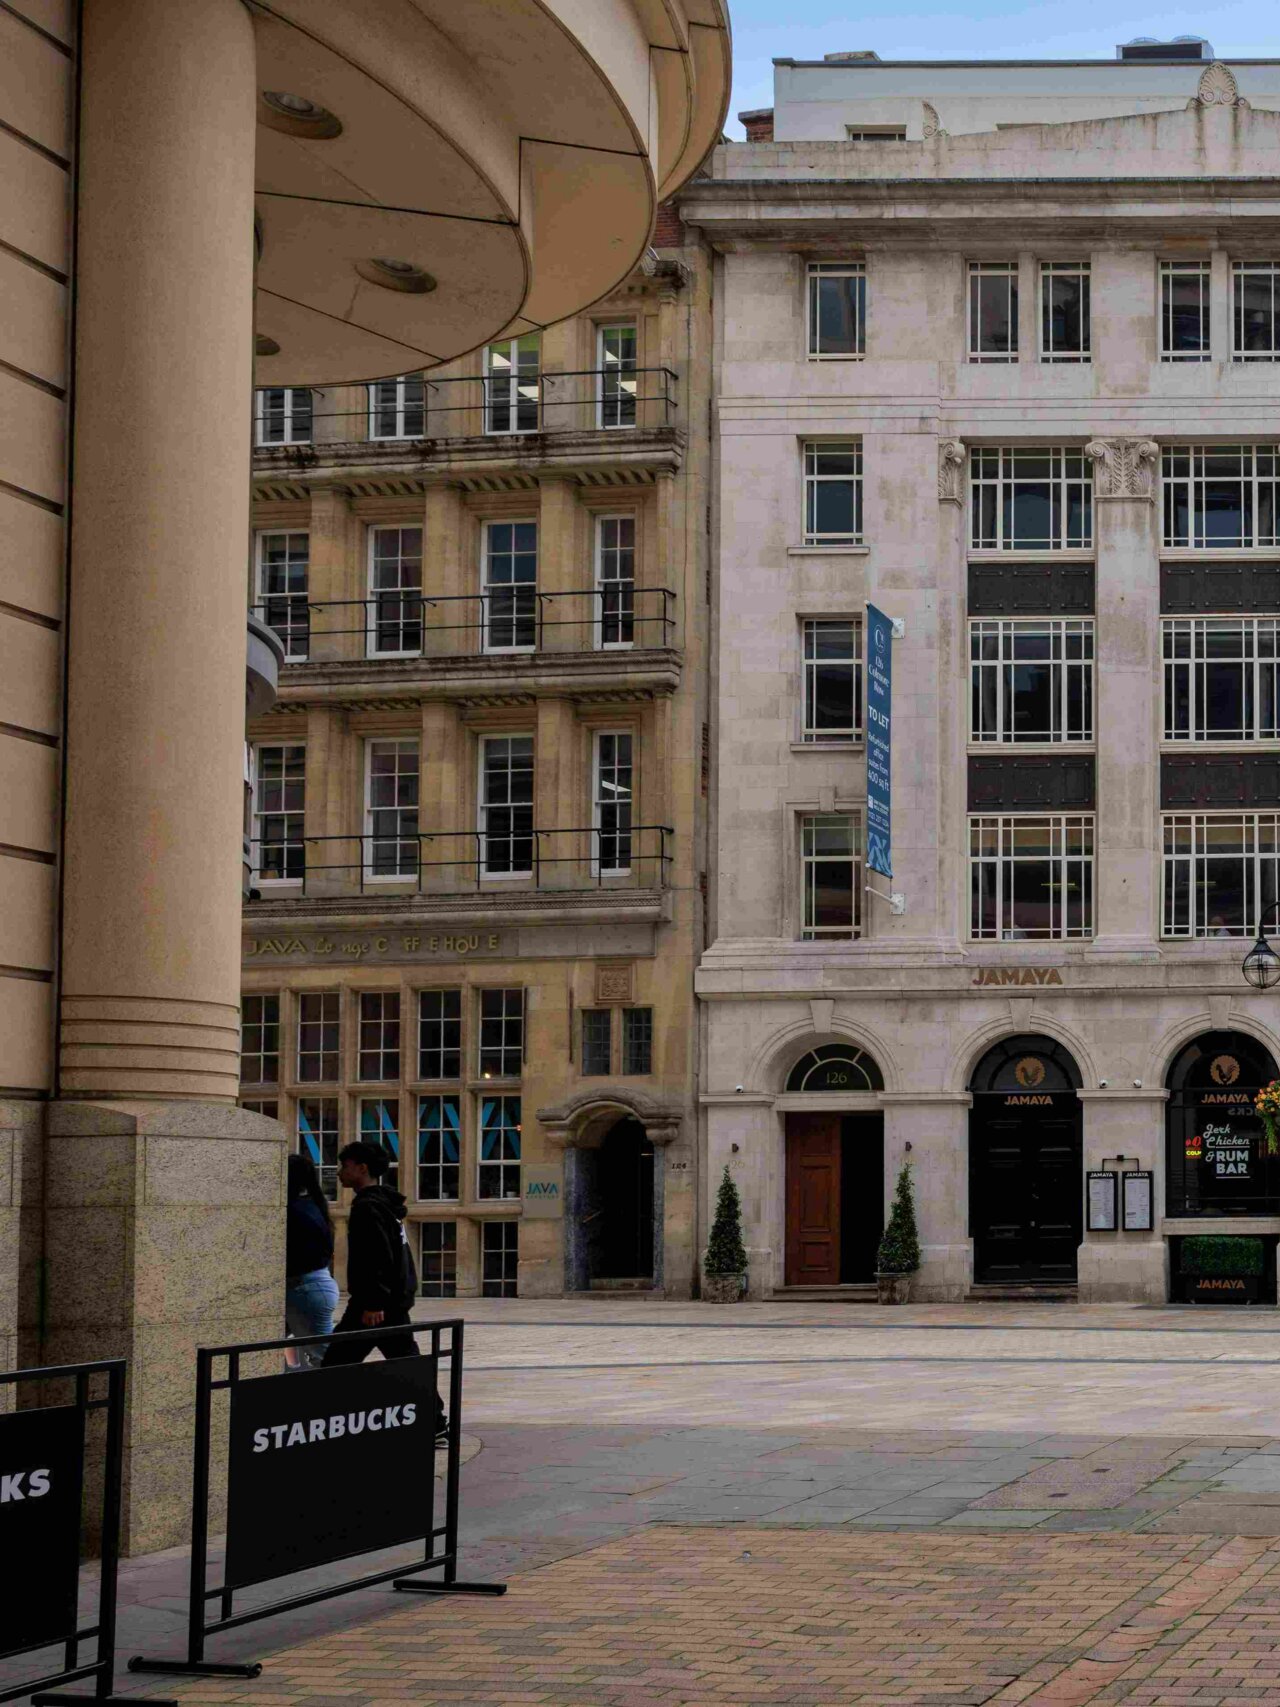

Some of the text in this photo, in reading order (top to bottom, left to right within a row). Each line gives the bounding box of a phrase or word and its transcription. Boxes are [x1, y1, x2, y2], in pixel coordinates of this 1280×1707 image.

[868, 704, 890, 730] TO LET
[244, 940, 307, 955] JAVA
[972, 968, 1063, 985] JAMAYA
[826, 1071, 848, 1084] 126
[1004, 1095, 1053, 1105] JAMAYA
[1201, 1093, 1250, 1104] JAMAYA
[1203, 1123, 1231, 1139] Jerk
[1205, 1135, 1251, 1148] Chicken
[1216, 1150, 1249, 1162] RUM
[1216, 1163, 1248, 1174] BAR
[526, 1182, 559, 1194] JAVA
[1196, 1279, 1246, 1289] JAMAYA
[252, 1403, 417, 1453] STARBUCKS
[0, 1468, 51, 1503] KS
